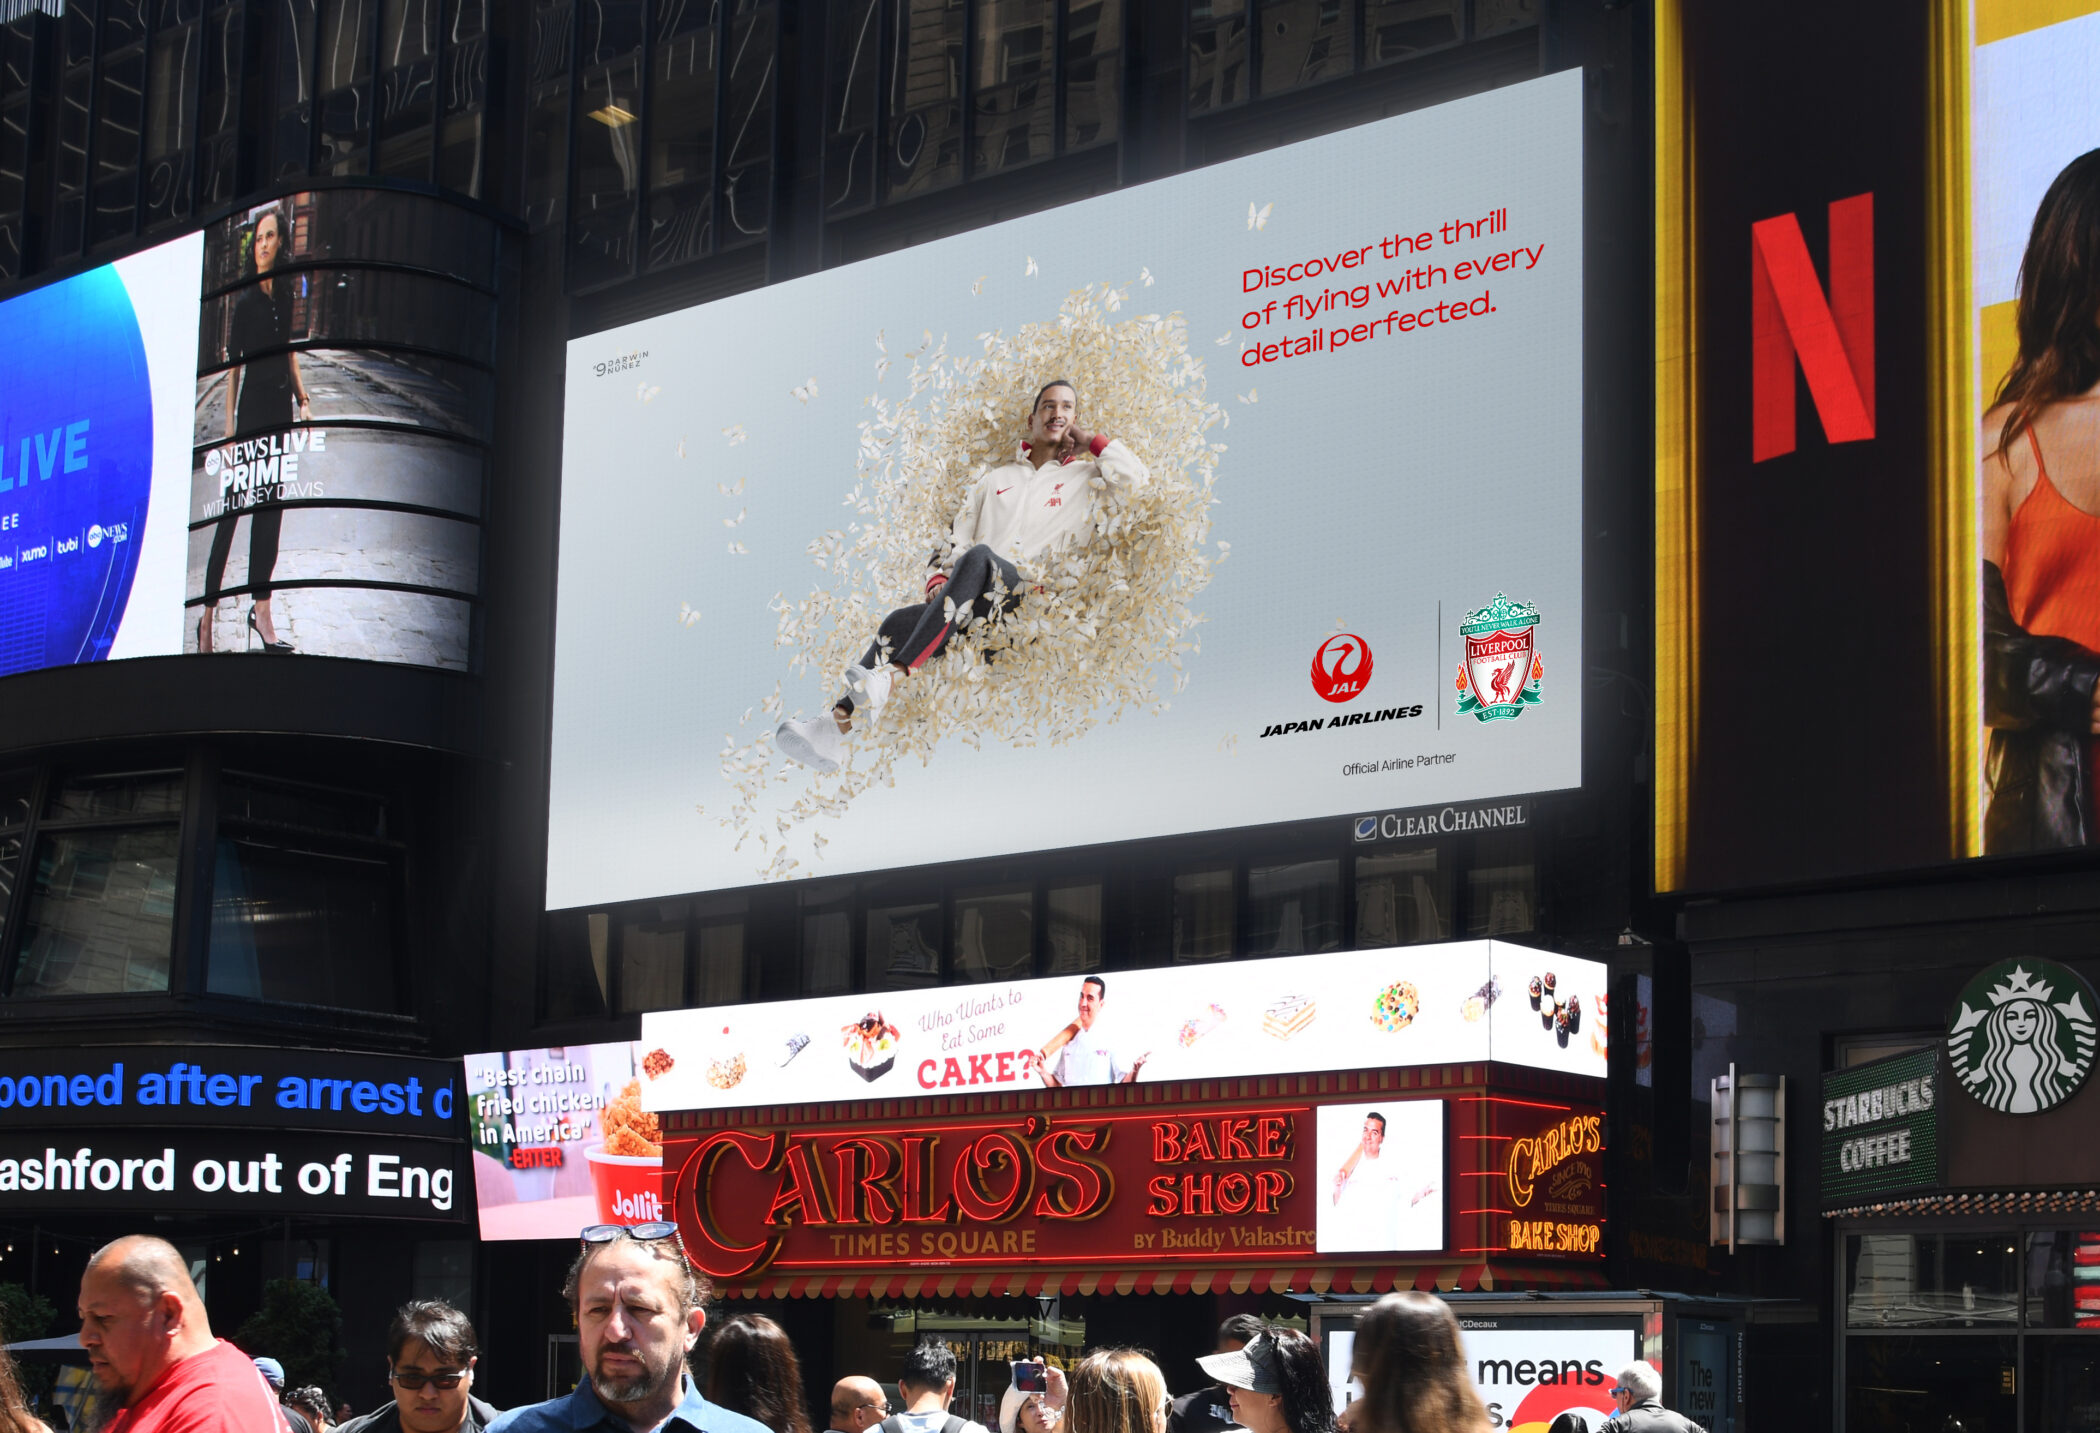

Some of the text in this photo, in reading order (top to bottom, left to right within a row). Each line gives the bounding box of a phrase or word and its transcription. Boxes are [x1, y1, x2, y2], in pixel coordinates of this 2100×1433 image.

[1242, 207, 1507, 293] Discover the thrill
[1241, 243, 1545, 330] of flying with every
[1241, 290, 1497, 367] detail perfected.
[608, 351, 648, 367] DARWIN
[0, 418, 90, 493] LIVE
[220, 454, 298, 497] PRIME
[203, 481, 324, 518] WITH LINSEY DAVIS
[57, 536, 79, 554] tubi
[102, 522, 128, 539] NEWS
[22, 545, 47, 562] xumo
[1481, 621, 1500, 630] NEVER
[1500, 619, 1518, 627] WALK
[1518, 616, 1539, 625] ALONE
[1471, 638, 1529, 657] LIVERPOOL
[1473, 651, 1527, 665] FOOTBALL CLUB
[1327, 681, 1361, 696] JAL
[1260, 704, 1424, 738] JAPAN AIRLINES
[1342, 751, 1457, 777] Official Airline Partner
[918, 988, 1022, 1032] Who Wants to
[941, 1022, 1005, 1051] Eat Some
[531, 1060, 585, 1085] chain
[917, 1049, 1036, 1089] CAKE?
[136, 1062, 263, 1106] after
[275, 1076, 423, 1116] arrest
[476, 1088, 606, 1117] fried chicken
[1823, 1075, 1934, 1132] STARBUCKS
[479, 1121, 499, 1145] in
[1152, 1114, 1295, 1165] BAKE
[1509, 1115, 1600, 1207] CARLO'S
[1840, 1129, 1912, 1173] COFFEE
[0, 1148, 453, 1211] ashford out of Eng
[1552, 1161, 1592, 1186] SINCE 1910
[673, 1115, 1115, 1277] CARLO'S
[1147, 1168, 1295, 1217] SHOP
[1544, 1202, 1596, 1216] TIMES SQUARE
[830, 1230, 1036, 1258] TIMES SQUARE
[1134, 1225, 1317, 1252] BY Buddy Valastro
[1510, 1220, 1554, 1250] BAKE
[1556, 1223, 1600, 1253] SHOP
[1478, 1359, 1604, 1386] means
[1689, 1360, 1713, 1387] The
[1689, 1390, 1715, 1410] new
